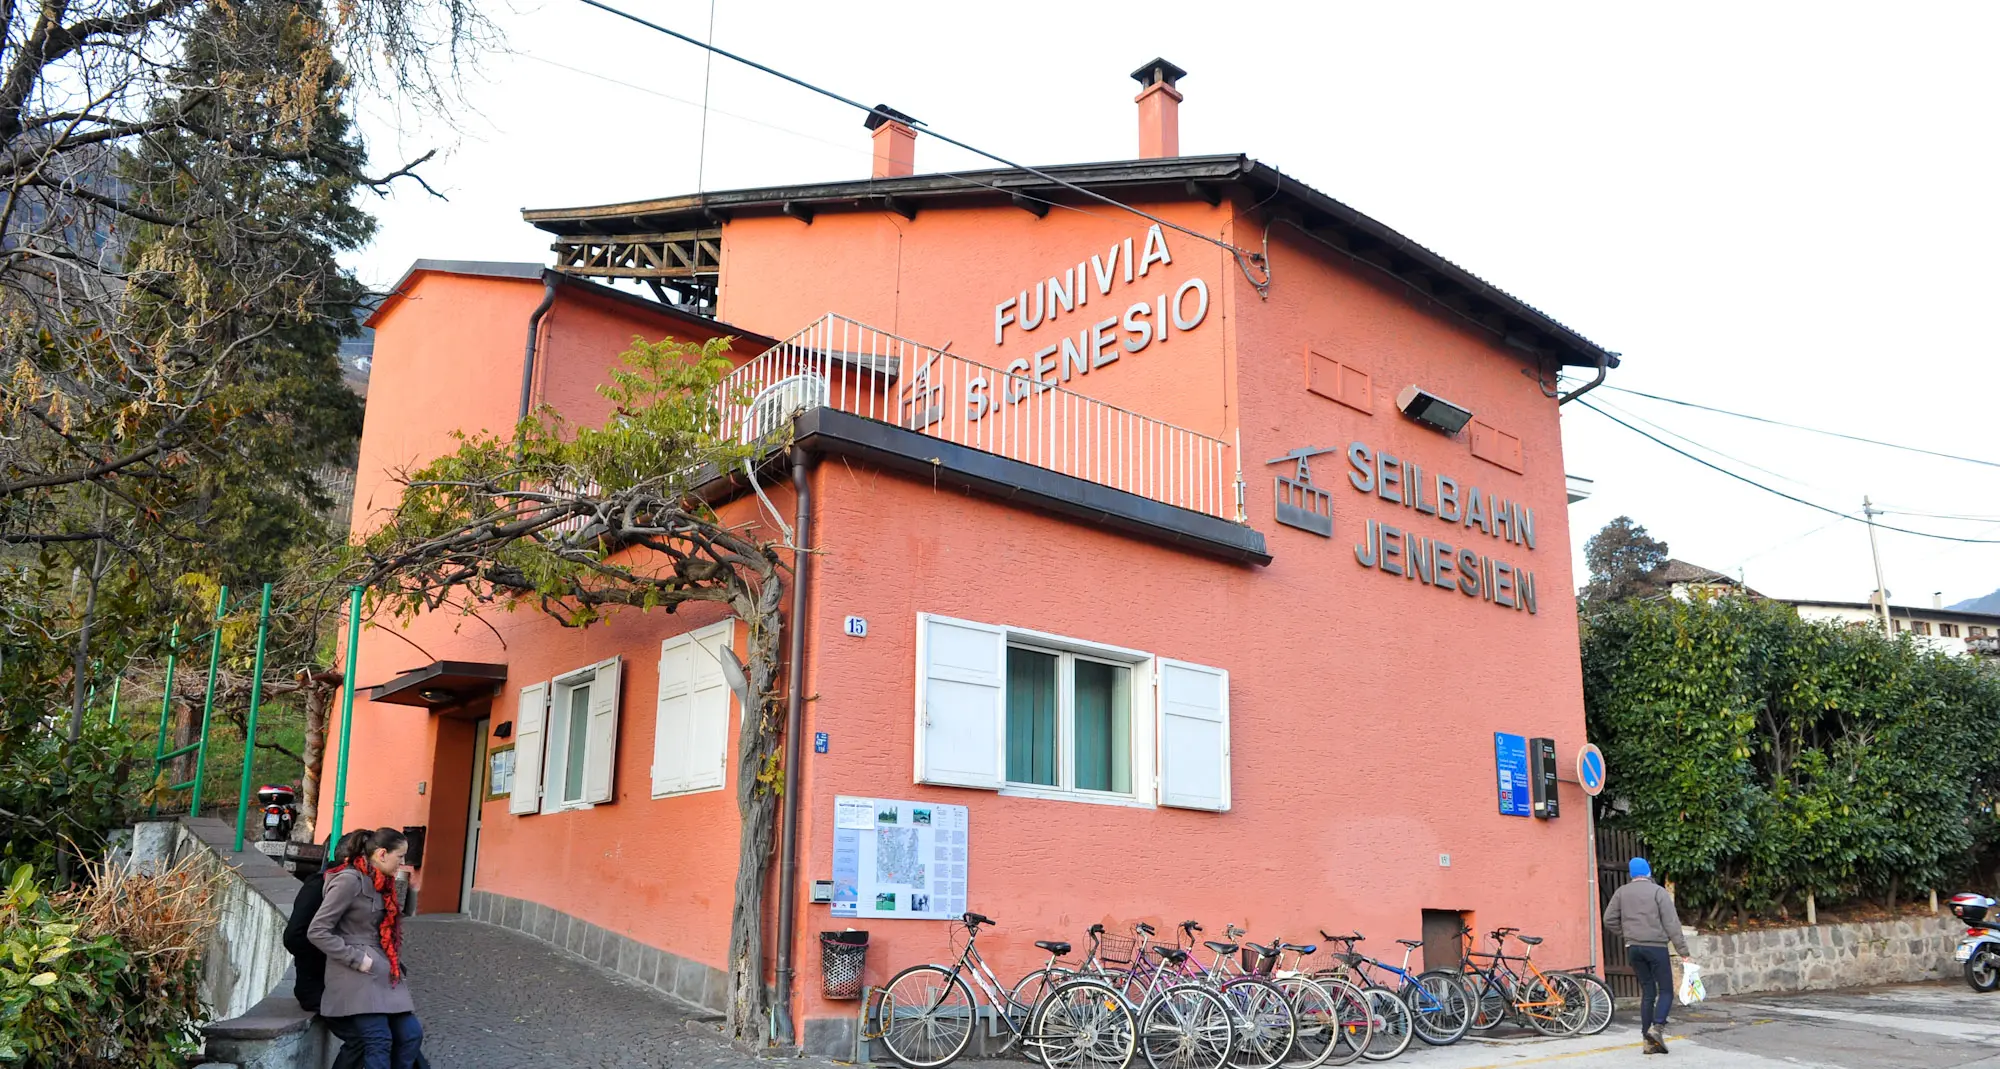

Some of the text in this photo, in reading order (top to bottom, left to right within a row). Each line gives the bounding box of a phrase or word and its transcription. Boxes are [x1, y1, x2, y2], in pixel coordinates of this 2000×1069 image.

[995, 223, 1172, 345] FUNIVIA
[1348, 441, 1536, 549] SEILBAHN
[1355, 519, 1537, 614] JENESIEN
[849, 618, 864, 635] 15
